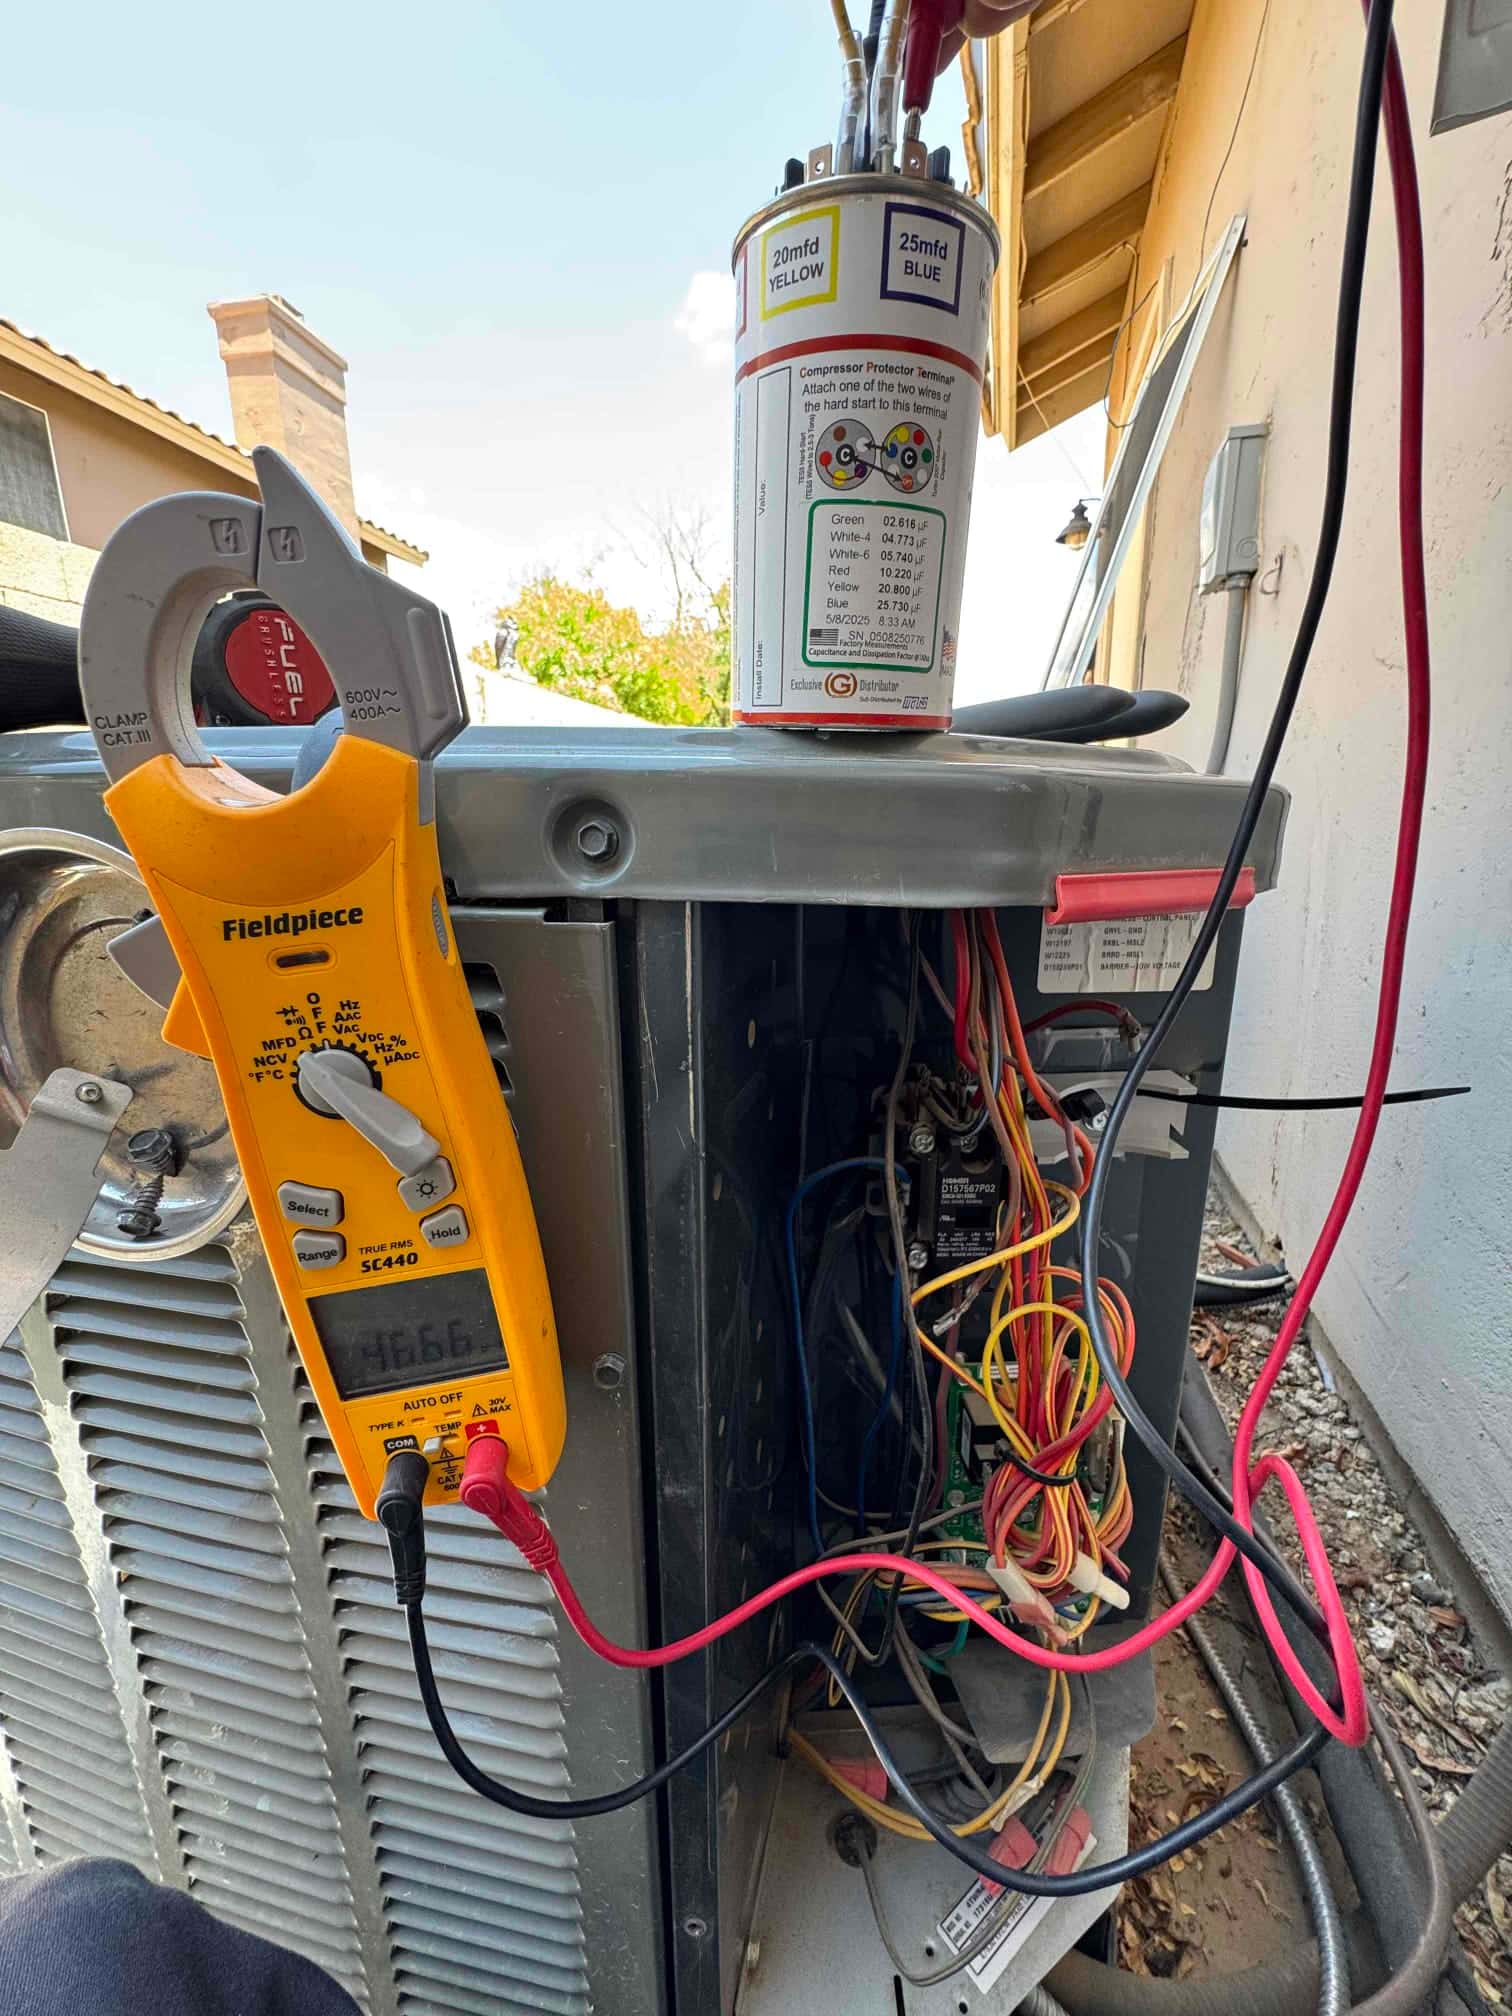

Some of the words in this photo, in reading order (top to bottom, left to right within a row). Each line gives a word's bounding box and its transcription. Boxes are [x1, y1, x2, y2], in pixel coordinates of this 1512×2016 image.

[773, 236, 820, 269] 20mfd
[899, 232, 948, 260] 25mfd
[769, 262, 824, 293] YELLOW
[903, 260, 941, 283] BLUE
[800, 363, 865, 379] Compressor
[866, 361, 914, 377] Protector
[802, 379, 836, 397] Attach
[839, 381, 861, 393] one
[864, 378, 876, 392] of
[877, 379, 895, 393] the
[897, 381, 916, 396] two
[917, 384, 942, 401] wires
[943, 391, 952, 403] of
[804, 399, 821, 413] the
[824, 395, 849, 410] hard
[851, 397, 876, 410] start
[879, 398, 890, 410] to
[892, 399, 910, 413] this
[913, 401, 948, 420] terminal
[840, 449, 851, 460] C
[904, 453, 914, 465] C
[758, 479, 767, 516] Value:
[831, 514, 865, 526] Green
[883, 516, 916, 530] 02.616
[830, 531, 871, 543] White-4
[882, 533, 914, 547] 04.773
[829, 549, 870, 560] White-6
[880, 551, 913, 564] 05.740
[828, 566, 850, 576] Red
[880, 567, 912, 580] 10.220
[828, 582, 860, 592] Yellow
[878, 584, 910, 596] 20.800
[826, 598, 849, 609] Blue
[877, 600, 909, 612] 25.730
[825, 614, 871, 626] 5/8/2025
[878, 616, 898, 627] 8:33
[901, 618, 916, 629] AM
[848, 630, 864, 641] SN
[840, 640, 863, 648] Factory
[865, 640, 908, 650] Measurements
[808, 648, 847, 657] Capacitance
[862, 649, 896, 658] Dissipation
[897, 652, 914, 660] Factor
[273, 616, 305, 717] FUEL
[791, 679, 822, 691] Exclusive
[859, 679, 900, 692] Distributor
[95, 712, 149, 731] CLAMP
[222, 906, 364, 942] Fieldpiece
[339, 1000, 361, 1012] Hz
[261, 1036, 297, 1052] MFD
[253, 1053, 288, 1068] NCV
[287, 1200, 329, 1218] Select
[430, 1225, 462, 1240] Hold
[297, 1246, 338, 1263] Range
[359, 1242, 388, 1256] TRUE
[390, 1239, 414, 1251] RMS
[360, 1252, 419, 1274] SC440
[403, 1397, 438, 1412] AUTO
[439, 1391, 464, 1406] OFF
[489, 1396, 507, 1406] 30V
[489, 1403, 512, 1416] MAX
[368, 1421, 394, 1433] TYPE
[396, 1419, 405, 1429] K
[434, 1421, 463, 1433] TEMP
[386, 1437, 415, 1450] COM
[437, 1474, 457, 1486] CAT
[443, 1482, 461, 1491] 600
